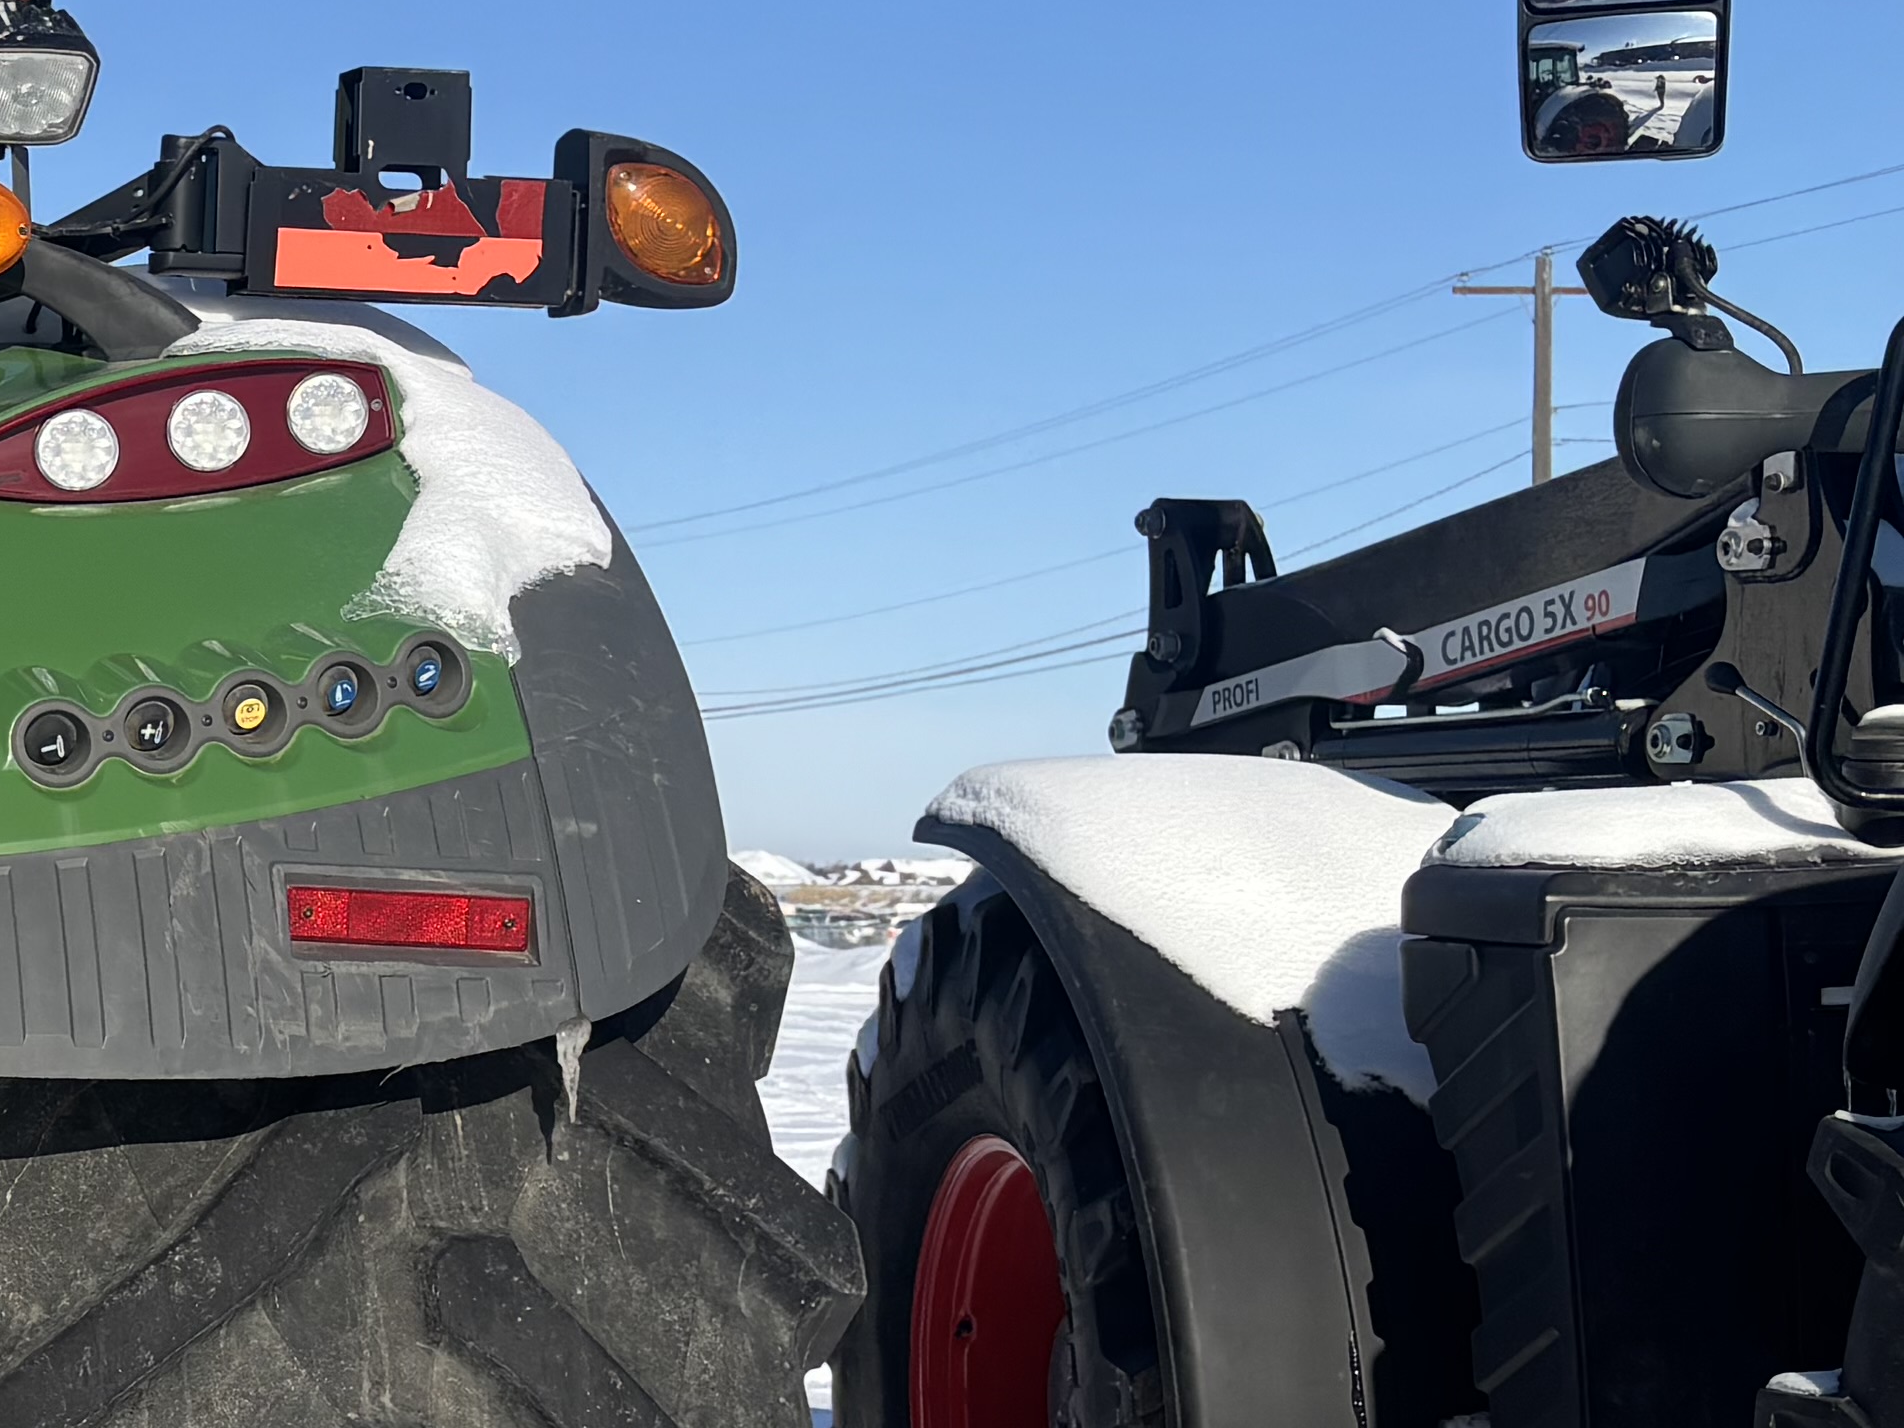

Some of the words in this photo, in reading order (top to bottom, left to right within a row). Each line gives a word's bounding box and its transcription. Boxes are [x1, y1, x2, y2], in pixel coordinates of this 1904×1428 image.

[1440, 610, 1535, 667] CARGO
[1543, 590, 1578, 635] 5X
[1583, 589, 1611, 623] 90
[1211, 677, 1260, 715] PROFI
